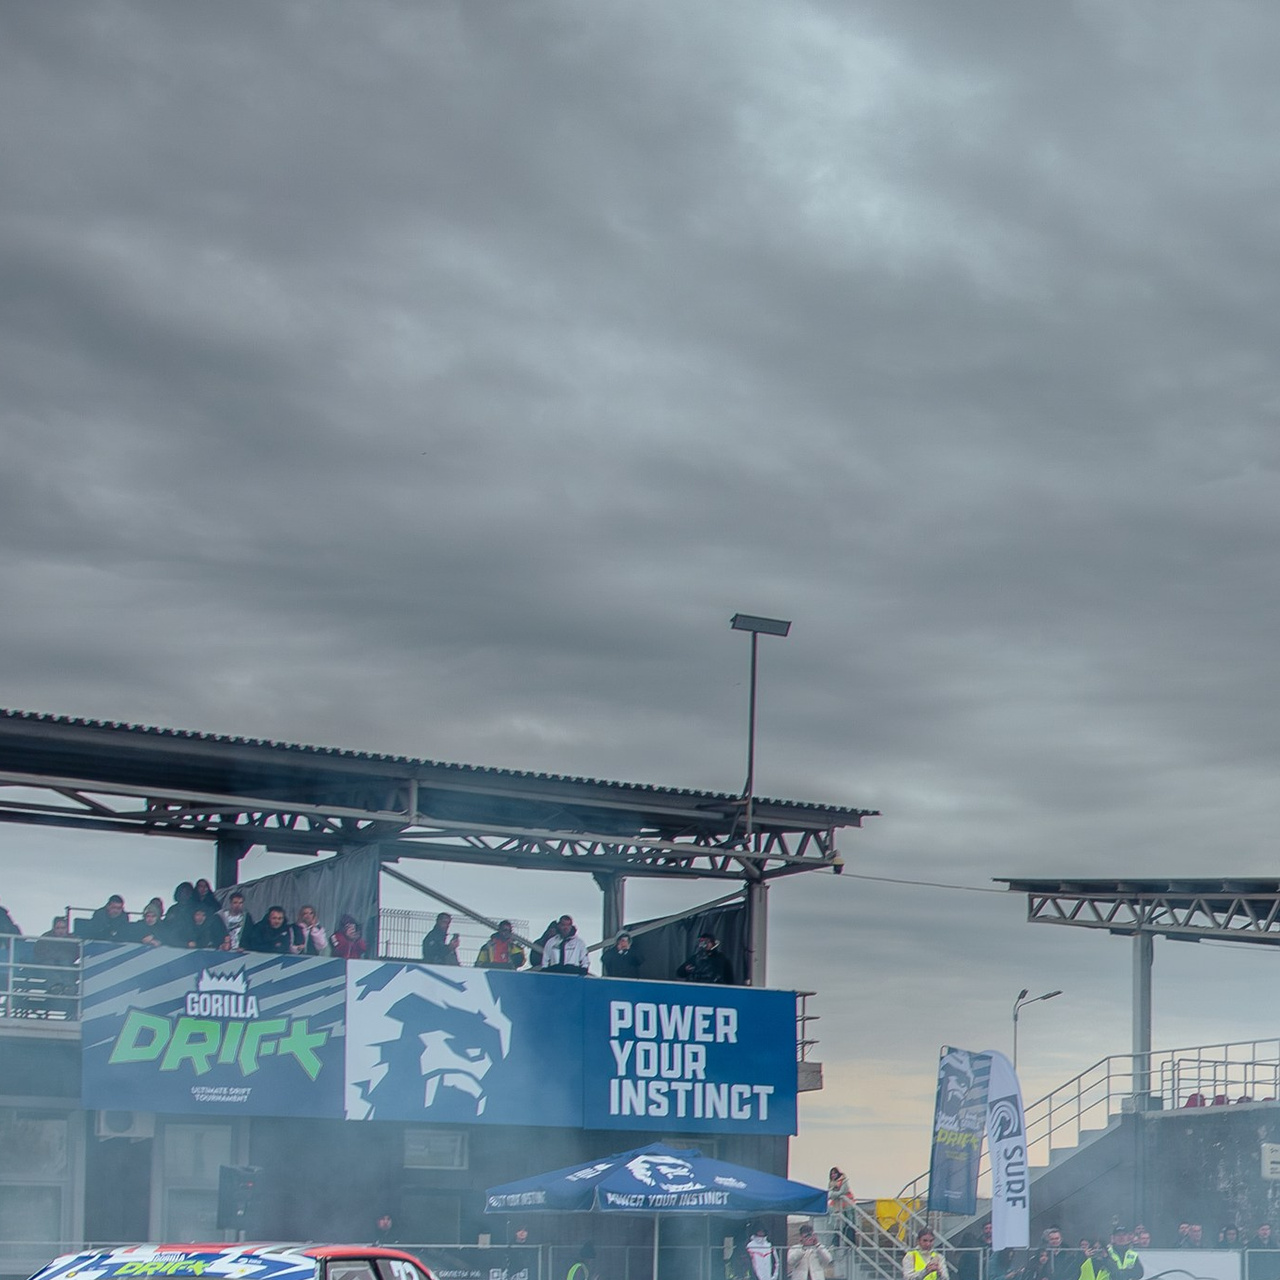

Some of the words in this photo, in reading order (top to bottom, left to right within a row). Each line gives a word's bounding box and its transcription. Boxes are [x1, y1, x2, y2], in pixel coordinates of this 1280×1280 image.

[186, 992, 259, 1018] GORILLA
[610, 1000, 738, 1043] POWER
[107, 1008, 330, 1082] DRIFT
[609, 1039, 707, 1080] YOUR
[610, 1078, 775, 1121] INSTINCT
[1004, 1144, 1027, 1210] SURF
[606, 1192, 646, 1208] POWER
[647, 1192, 677, 1208] YOUR
[678, 1190, 731, 1207] INSTINCT
[112, 1259, 211, 1277] DRIFT
